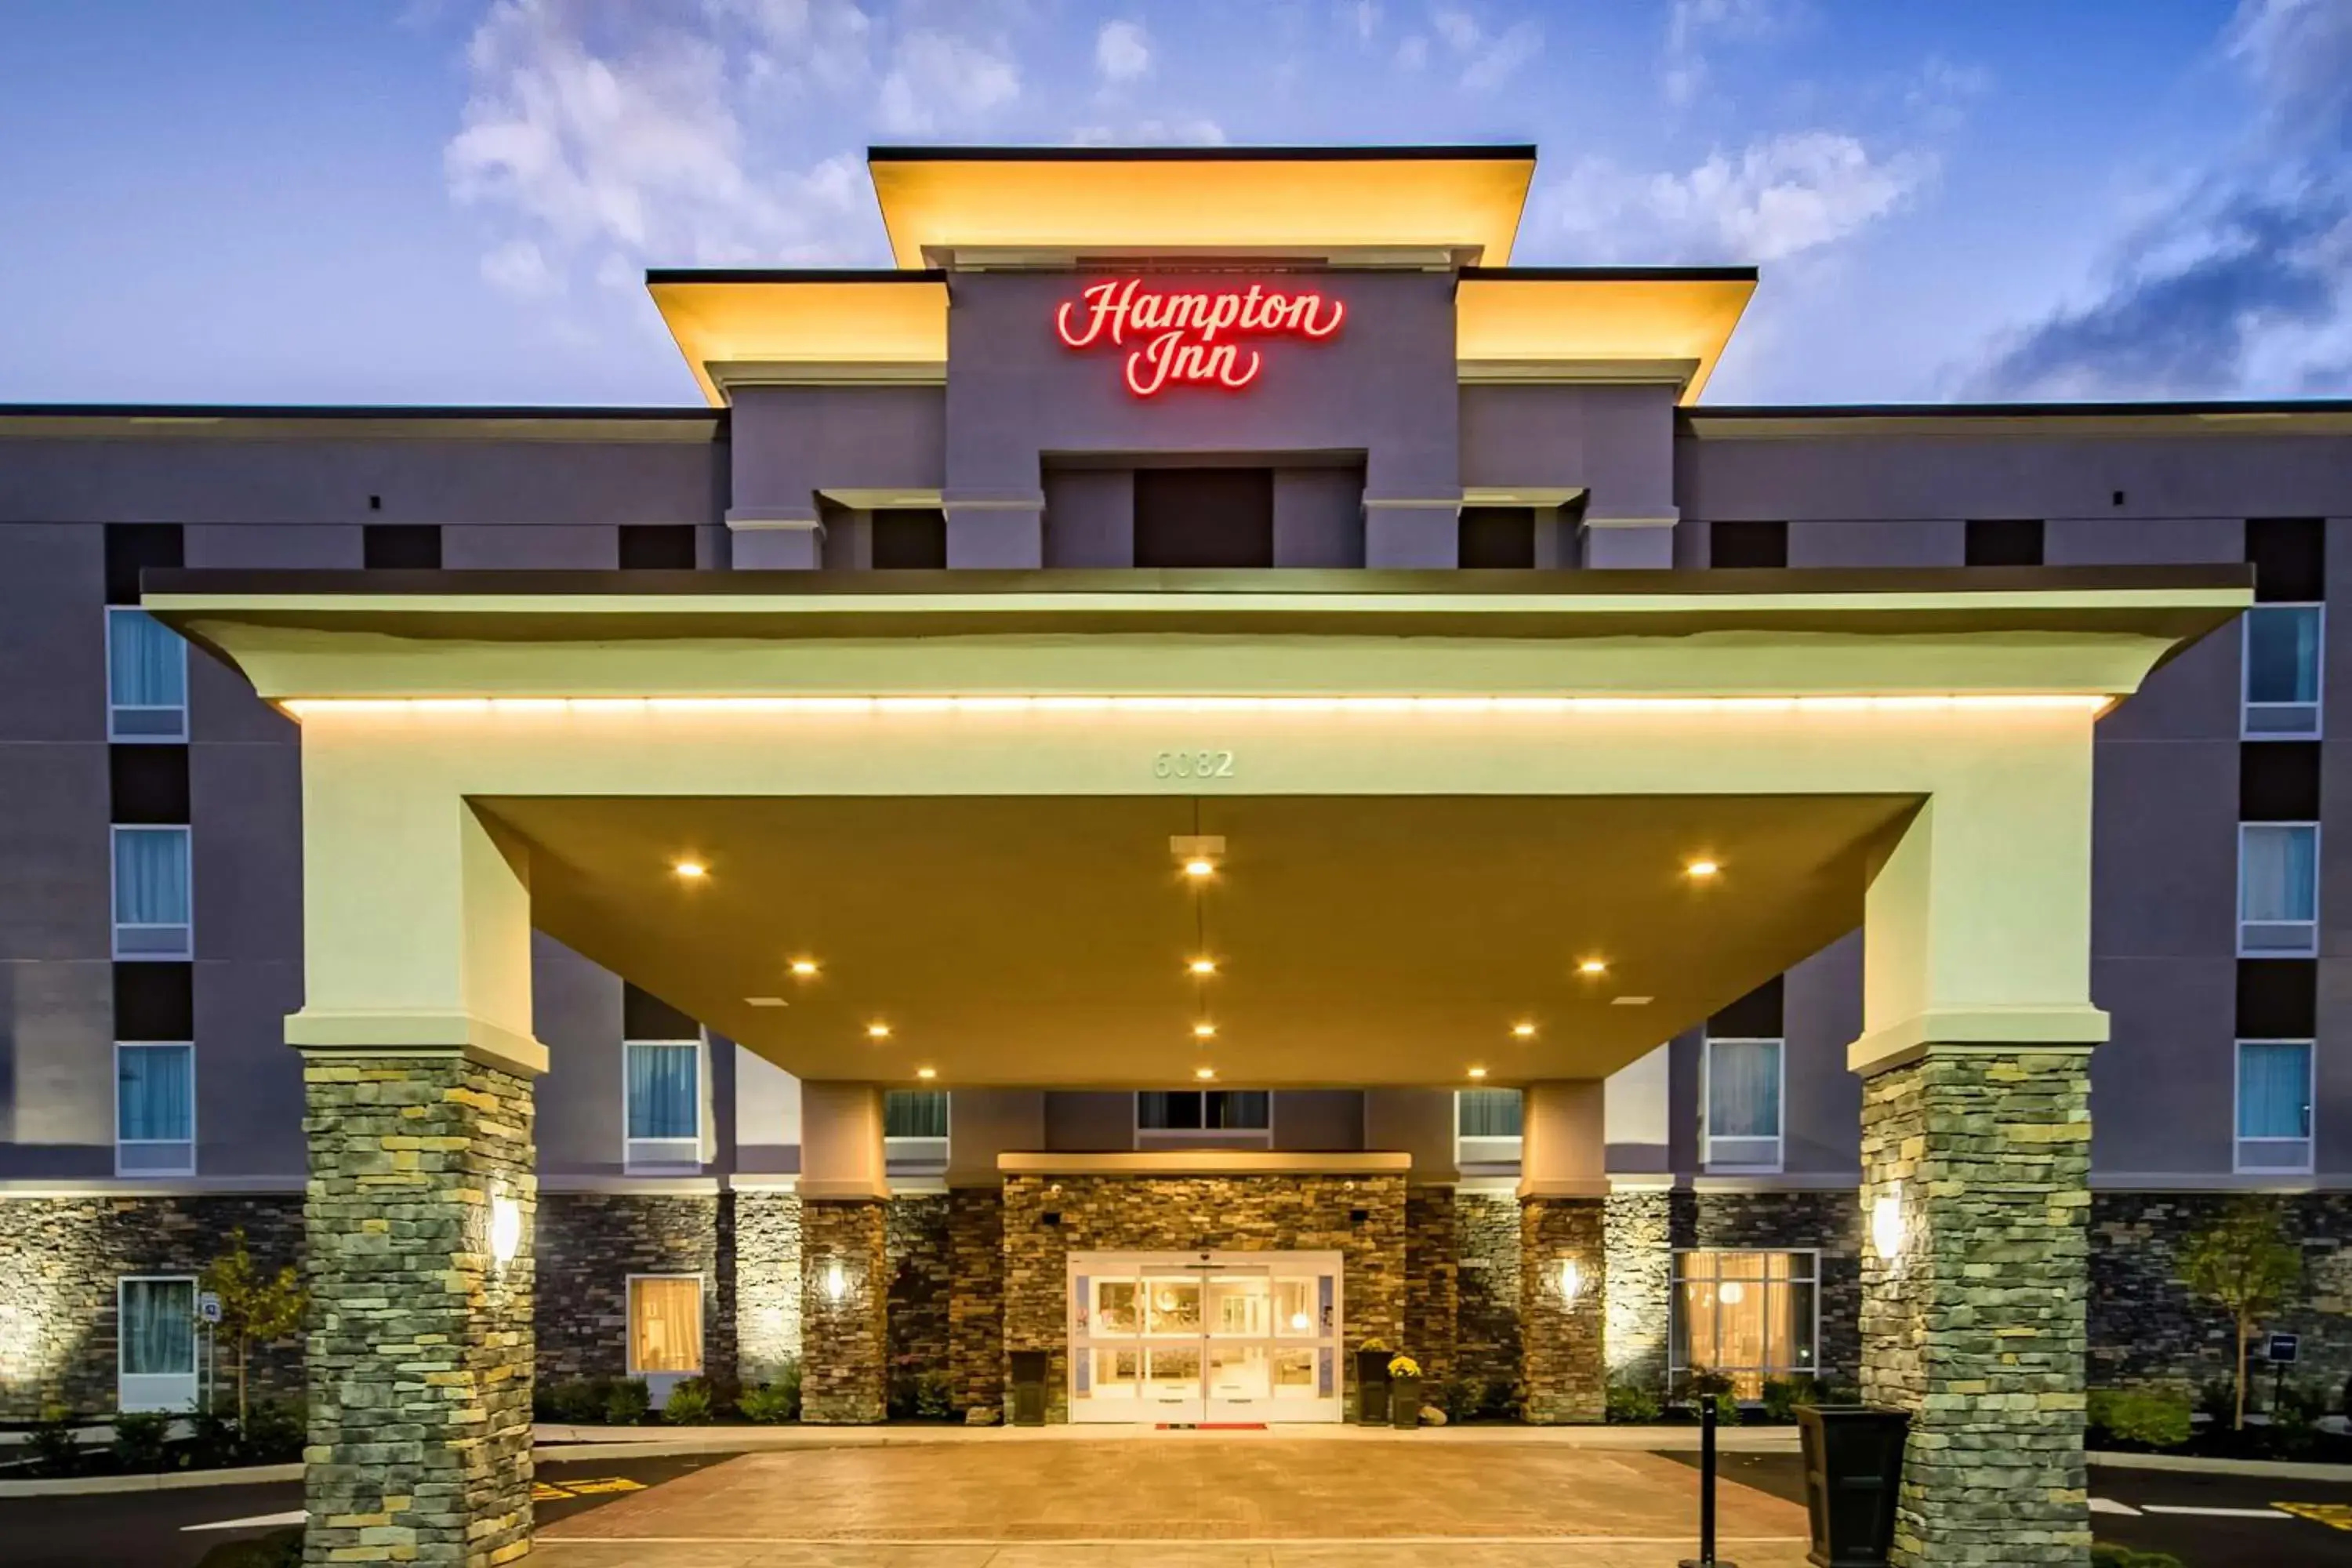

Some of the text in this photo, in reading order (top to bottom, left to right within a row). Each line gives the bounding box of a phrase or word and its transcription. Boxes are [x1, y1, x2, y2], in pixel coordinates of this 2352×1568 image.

[1058, 278, 1344, 346] Hampton
[1127, 330, 1261, 394] Inn
[1155, 750, 1234, 778] 6082
